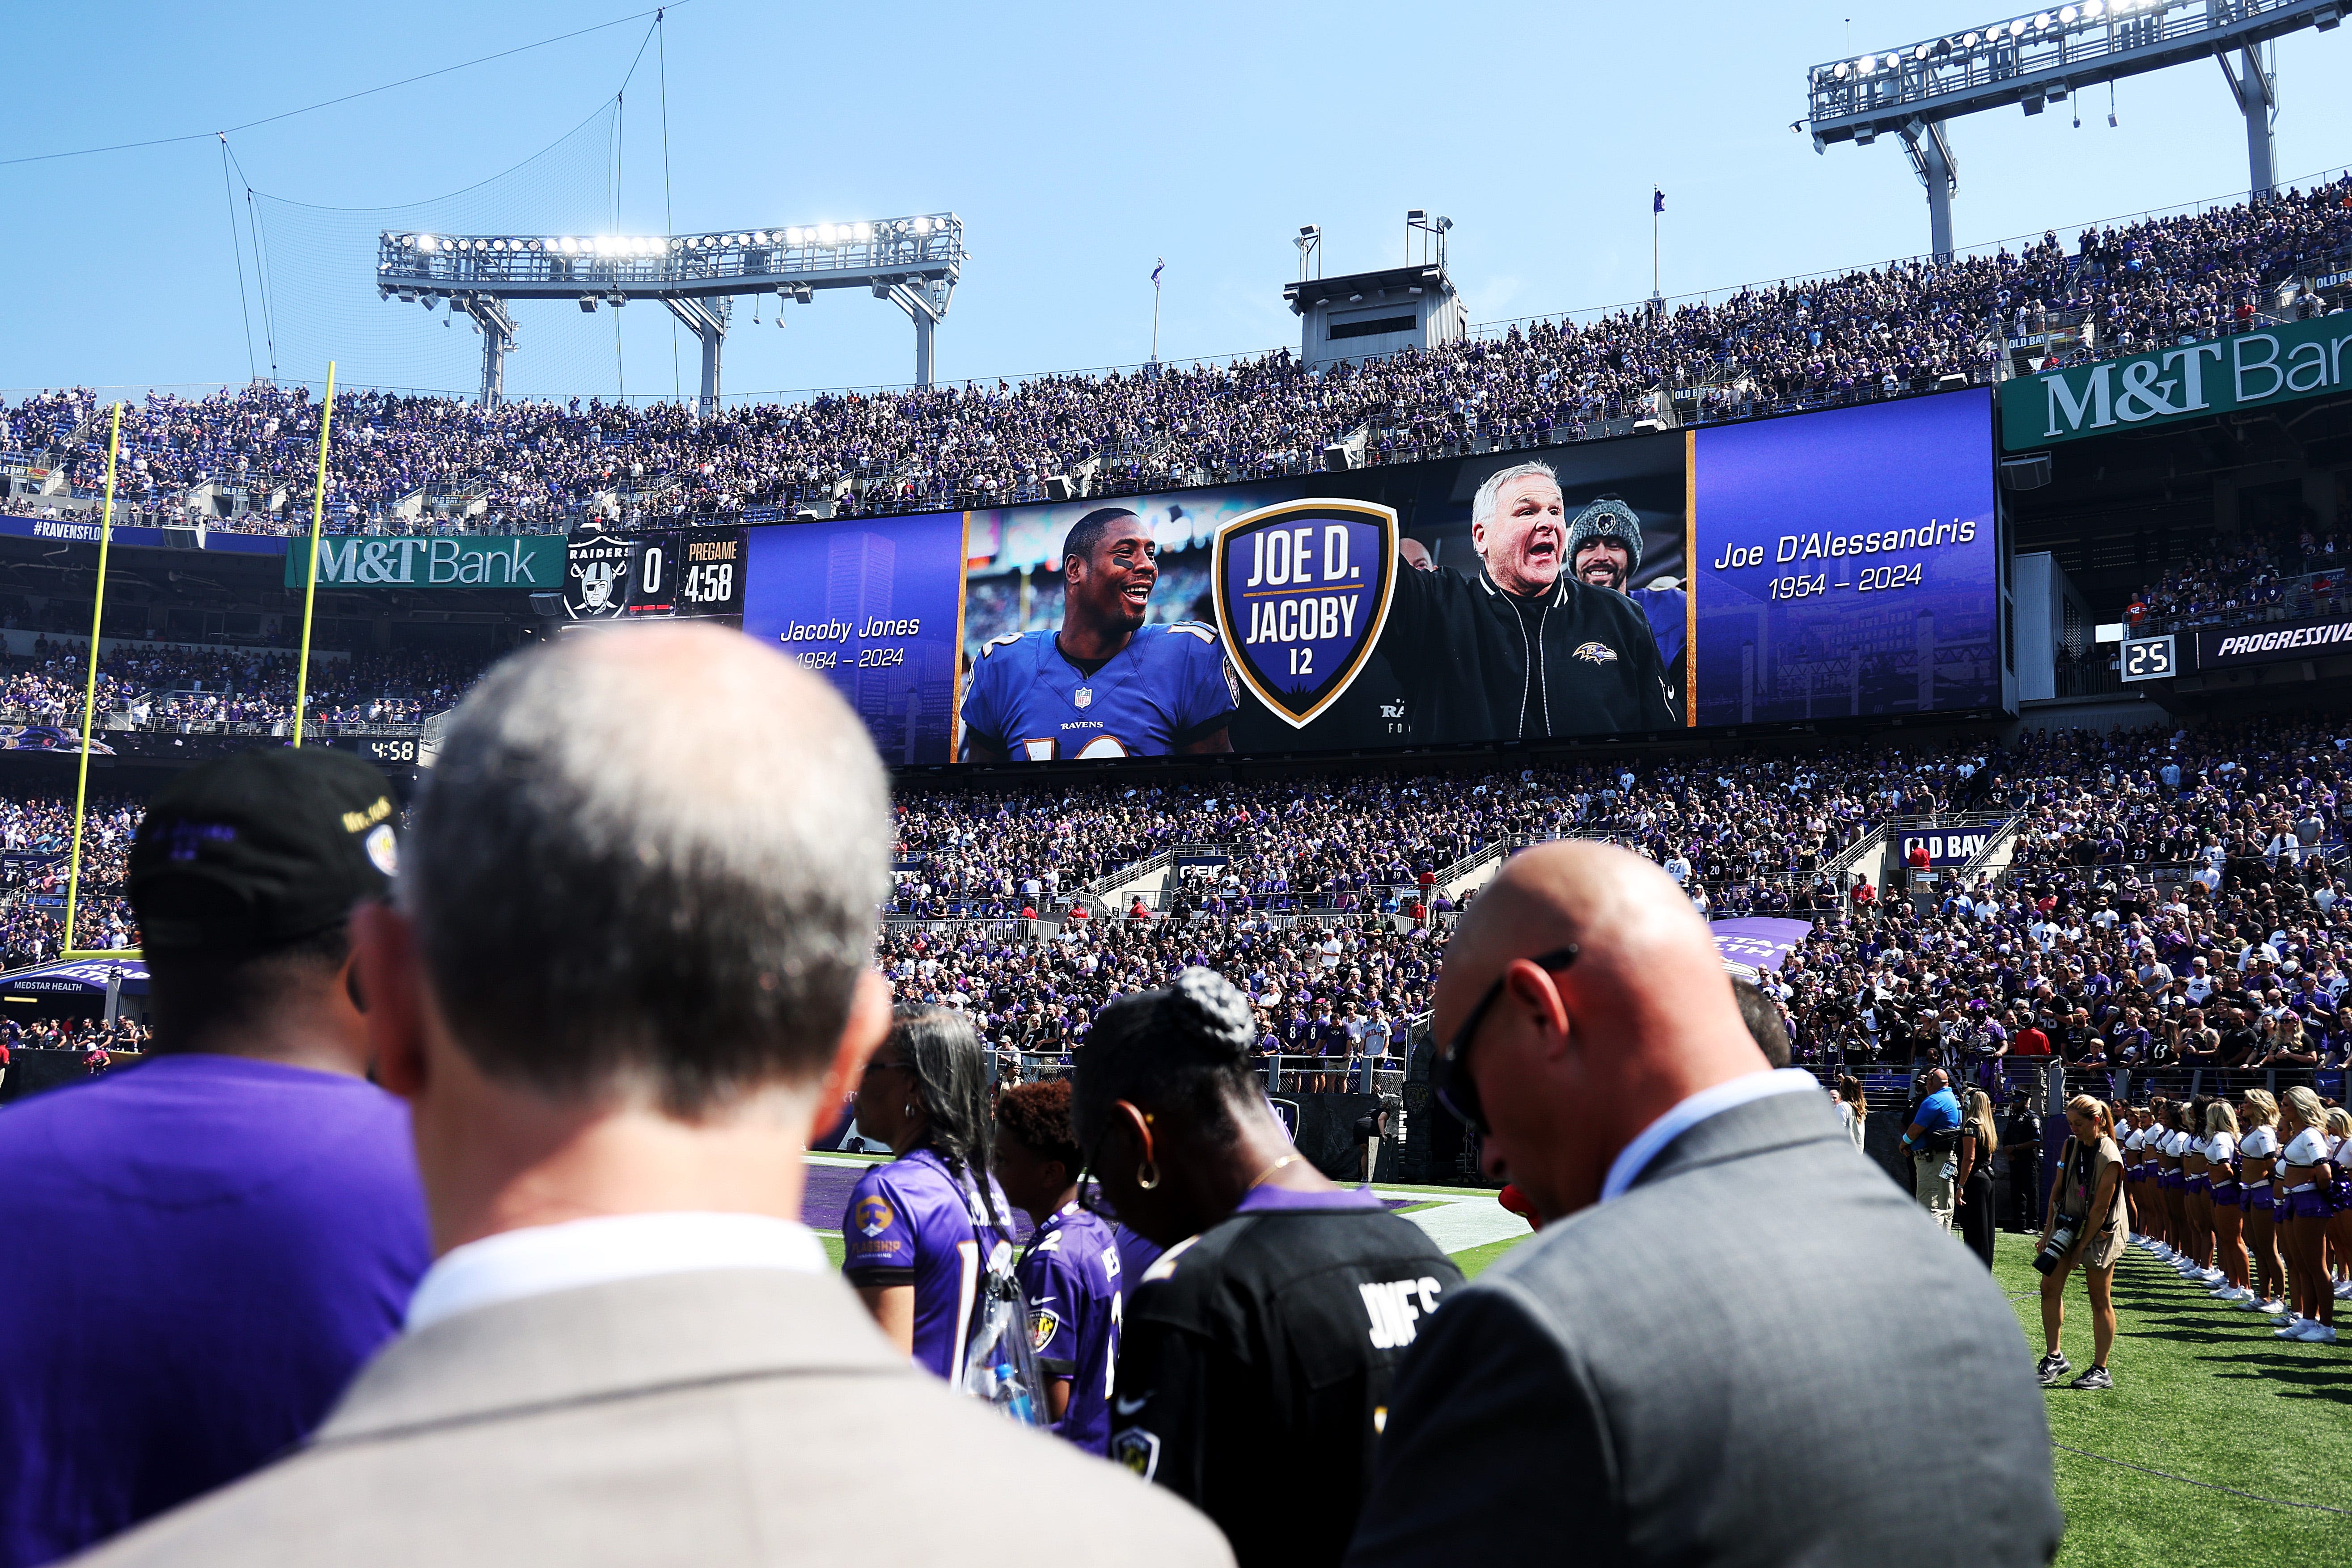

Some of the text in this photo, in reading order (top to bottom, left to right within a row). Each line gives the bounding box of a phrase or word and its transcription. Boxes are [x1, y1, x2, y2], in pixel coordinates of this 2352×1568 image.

[2256, 190, 2266, 200] 516
[1938, 254, 1946, 264] 515
[2316, 275, 2336, 288] OLD
[1619, 337, 1626, 345] 89
[2009, 334, 2043, 349] OLD BAY
[1675, 389, 1690, 399] OLD
[2040, 342, 2222, 437] M&T
[34, 521, 114, 541] #RAVENSFLOK
[1714, 518, 1976, 569] Joe D'Alessandris
[570, 547, 628, 559] RAIDERS
[689, 541, 737, 562] PREGAME
[1247, 524, 1360, 587] JOE D.
[314, 539, 536, 583] M&T Bank
[643, 548, 662, 593] 0
[685, 563, 733, 603] 4:58
[1769, 573, 1825, 599] 1954
[1858, 562, 1922, 591] 2024
[1246, 595, 1359, 644] JACOBY
[780, 616, 920, 643] Jacoby Jones
[2218, 623, 2352, 656] PROGRESSIVE
[796, 651, 837, 669] 1984
[859, 648, 904, 667] 2024
[1290, 647, 1313, 675] 12
[2129, 643, 2168, 674] 25
[1060, 721, 1104, 730] RAVENS
[1388, 723, 1409, 734] FO
[372, 740, 414, 761] 4:58
[2140, 787, 2149, 795] 89
[1992, 792, 2001, 801] 52
[2093, 823, 2099, 831] 8
[1948, 834, 1986, 858] BAY
[2160, 842, 2165, 853] 8
[2134, 849, 2145, 859] 23
[2183, 848, 2187, 857] 0
[2017, 853, 2027, 863] 55
[2040, 854, 2047, 863] 86
[1668, 864, 1681, 873] 87
[1710, 865, 1719, 875] 20
[6, 873, 13, 881] 8
[1393, 871, 1400, 879] 89
[28, 878, 36, 886] 89
[1187, 879, 1197, 888] 27
[916, 908, 920, 916] 4
[988, 907, 993, 915] 8
[1897, 904, 1902, 913] 5
[2026, 918, 2033, 929] 8
[1178, 930, 1185, 938] 20
[2040, 931, 2051, 942] 12
[1228, 940, 1232, 948] 8
[1866, 951, 1871, 959] 8
[943, 957, 948, 967] 8
[1102, 961, 1106, 970] 8
[1407, 968, 1415, 978] 22
[1997, 975, 2002, 985] 8
[14, 981, 82, 991] MEDSTAR HEALTH
[2083, 984, 2096, 995] 89
[1074, 1027, 1083, 1035] 89
[1290, 1026, 1295, 1039] 8
[1310, 1027, 1316, 1039] 8
[2114, 1022, 2124, 1034] 8
[2154, 1044, 2168, 1058] 13
[2344, 1042, 2350, 1057] 9
